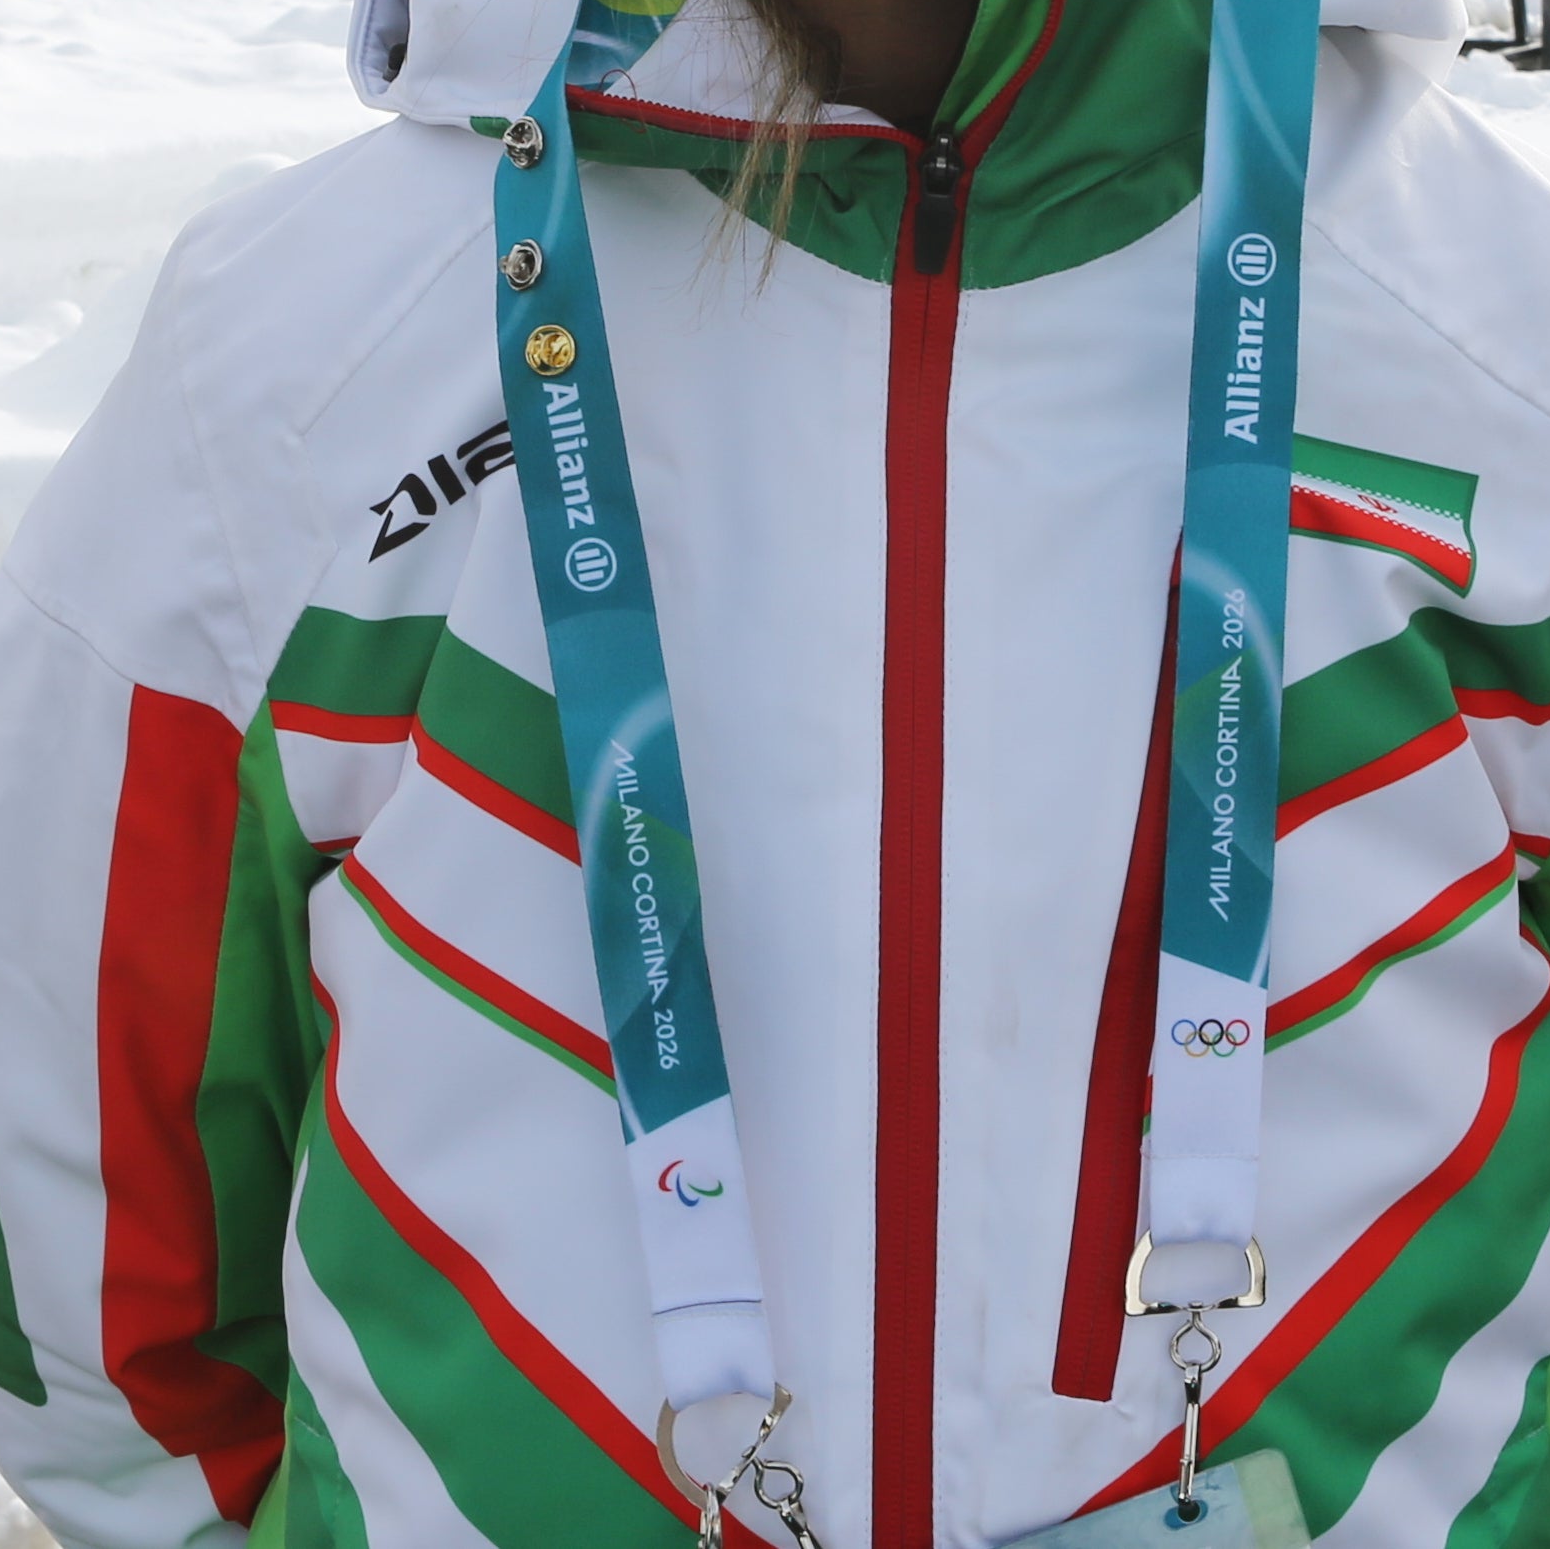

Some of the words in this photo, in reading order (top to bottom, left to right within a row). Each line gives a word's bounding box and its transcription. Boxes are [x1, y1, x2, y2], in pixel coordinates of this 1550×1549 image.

[1224, 297, 1266, 445] Allianz
[542, 382, 595, 530] Allianz
[1222, 587, 1246, 649] 2026
[1215, 656, 1243, 789] CORTINA
[610, 739, 649, 868] MILANO
[632, 872, 669, 1005] CORTINA
[653, 1007, 681, 1071] 2026
[1209, 793, 1233, 922] MILANO
